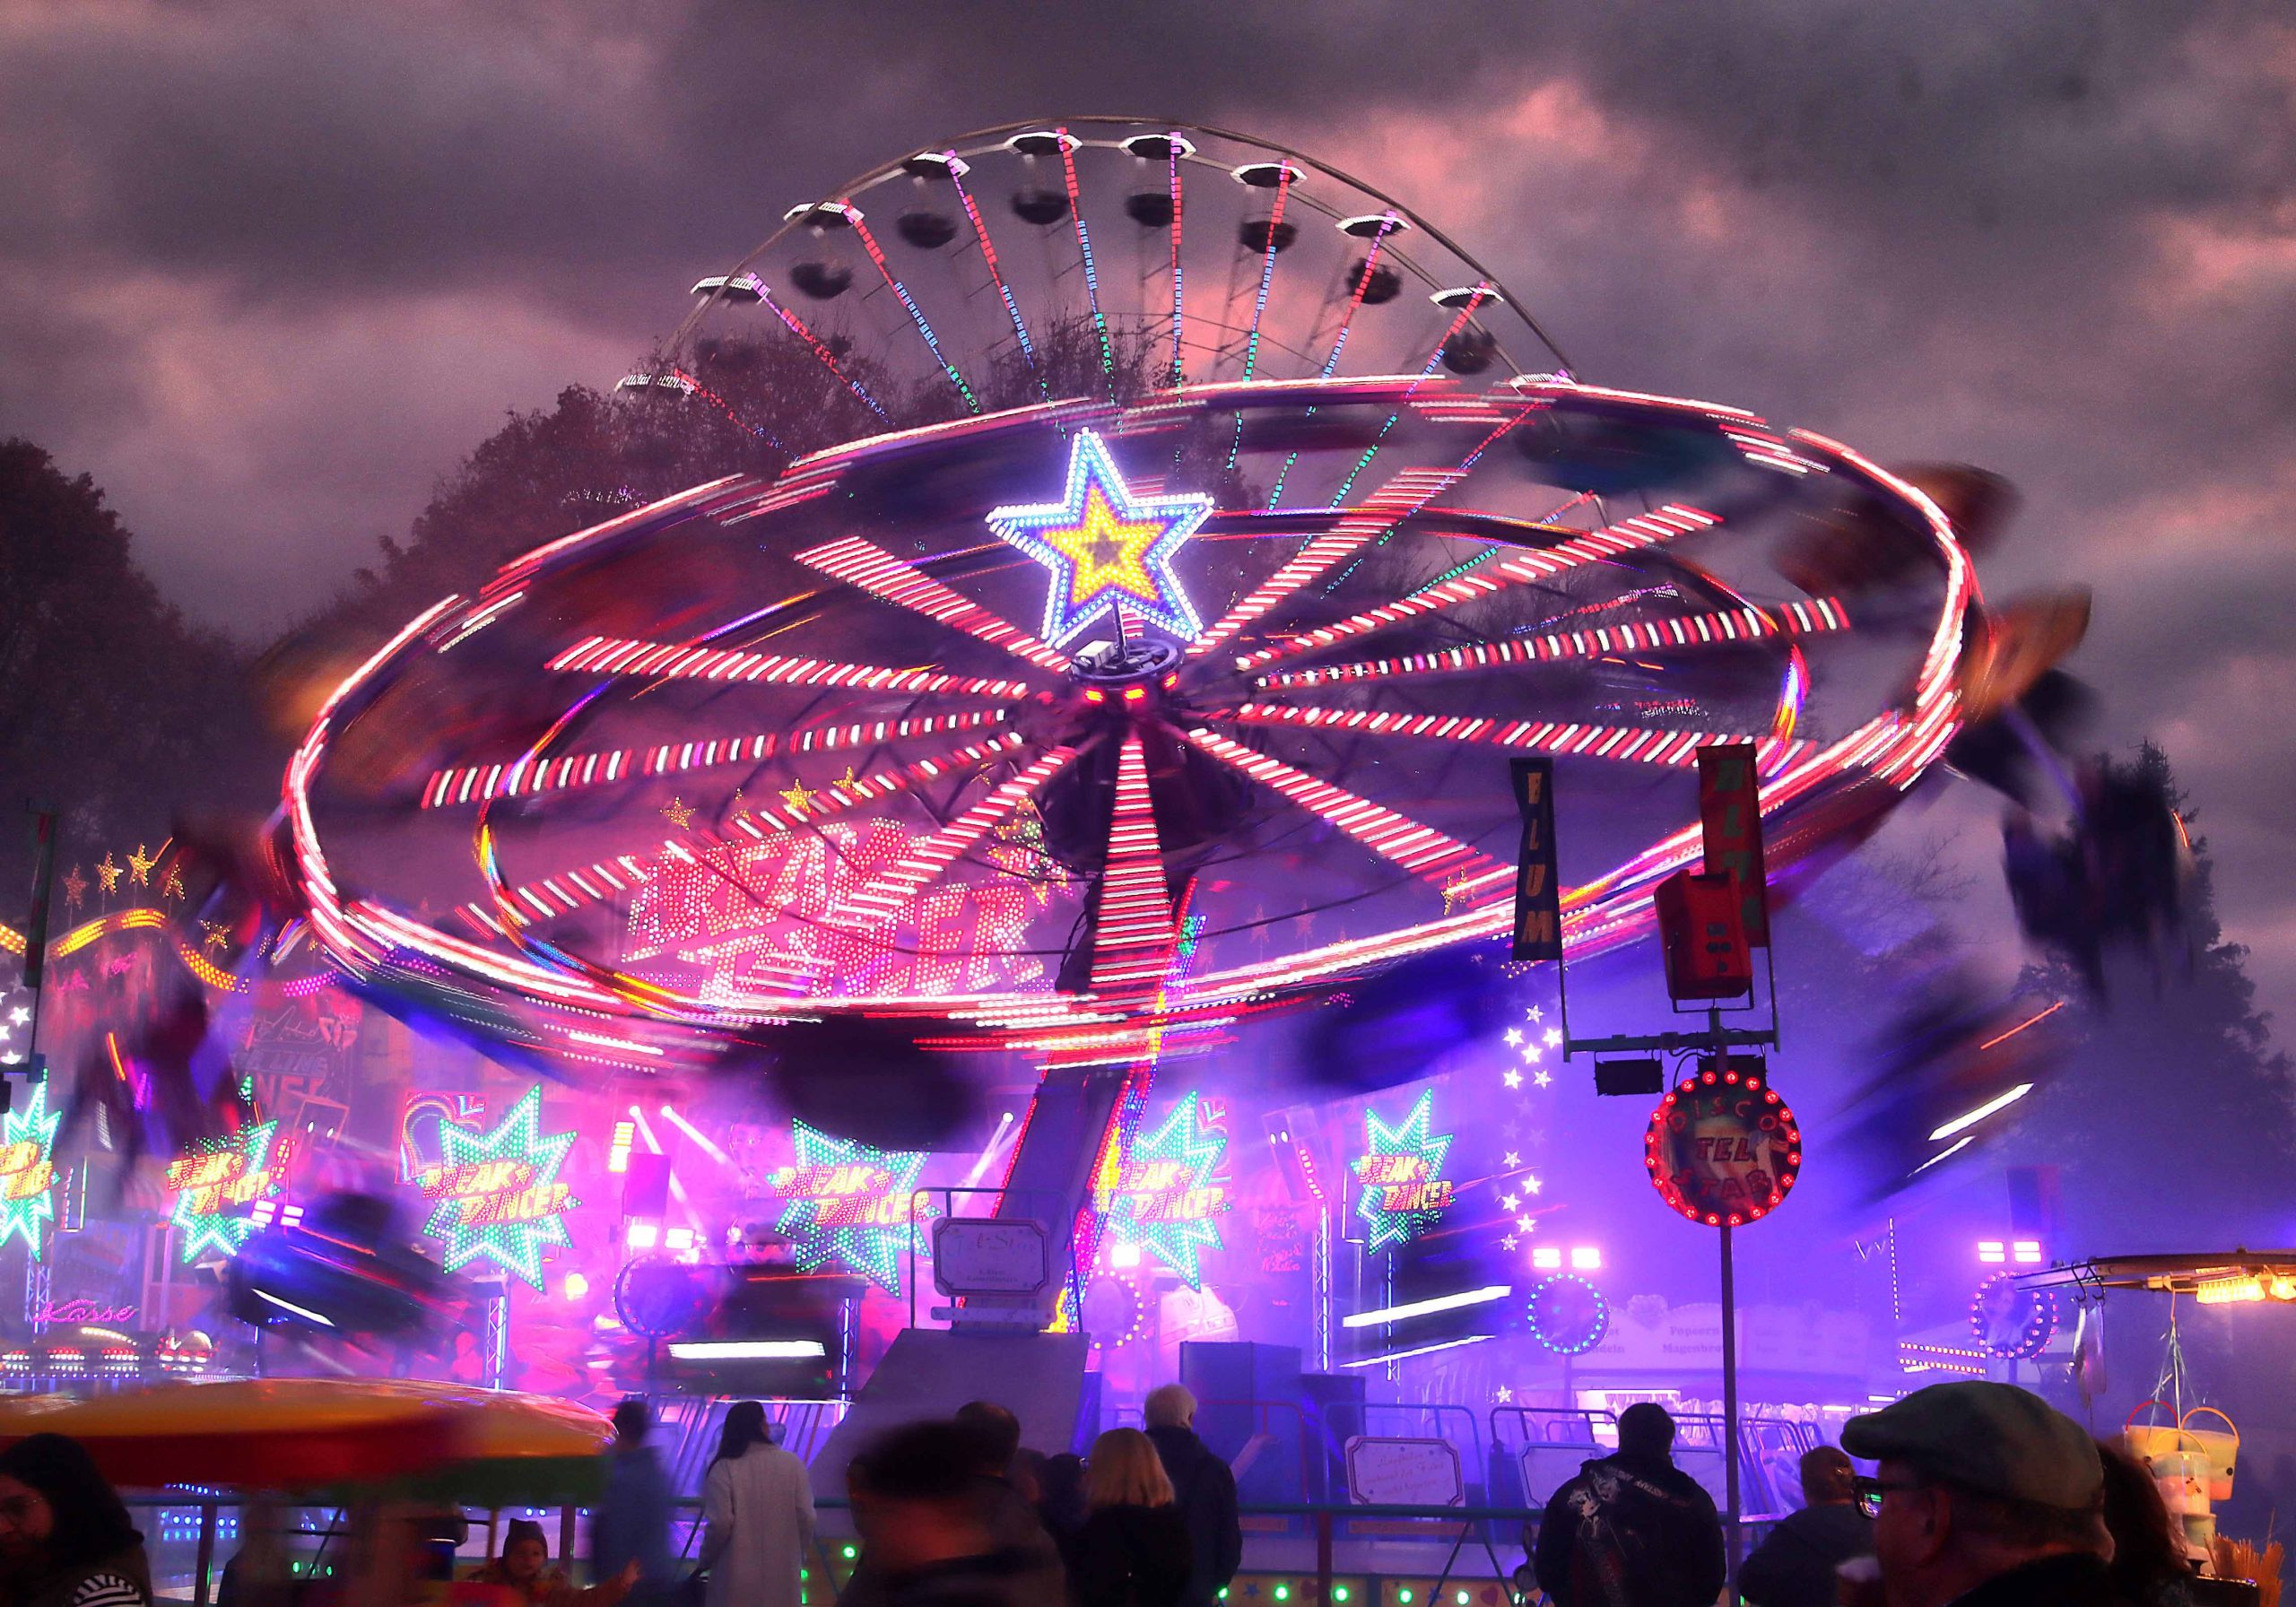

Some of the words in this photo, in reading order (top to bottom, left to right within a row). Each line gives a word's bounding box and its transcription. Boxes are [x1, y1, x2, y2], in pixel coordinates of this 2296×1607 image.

[1666, 1096, 1779, 1134] DISCO
[1695, 1136, 1752, 1162] TEL
[422, 1161, 516, 1198] BREAK
[775, 1165, 875, 1198] BREAK
[1359, 1154, 1420, 1184] BREAK
[1669, 1168, 1773, 1200] STAR
[457, 1183, 571, 1225] DANCER
[813, 1191, 931, 1225] DANCER
[1132, 1187, 1224, 1220] DANCER
[1382, 1179, 1455, 1212] DANCER
[1662, 1343, 1723, 1355] Magenbro
